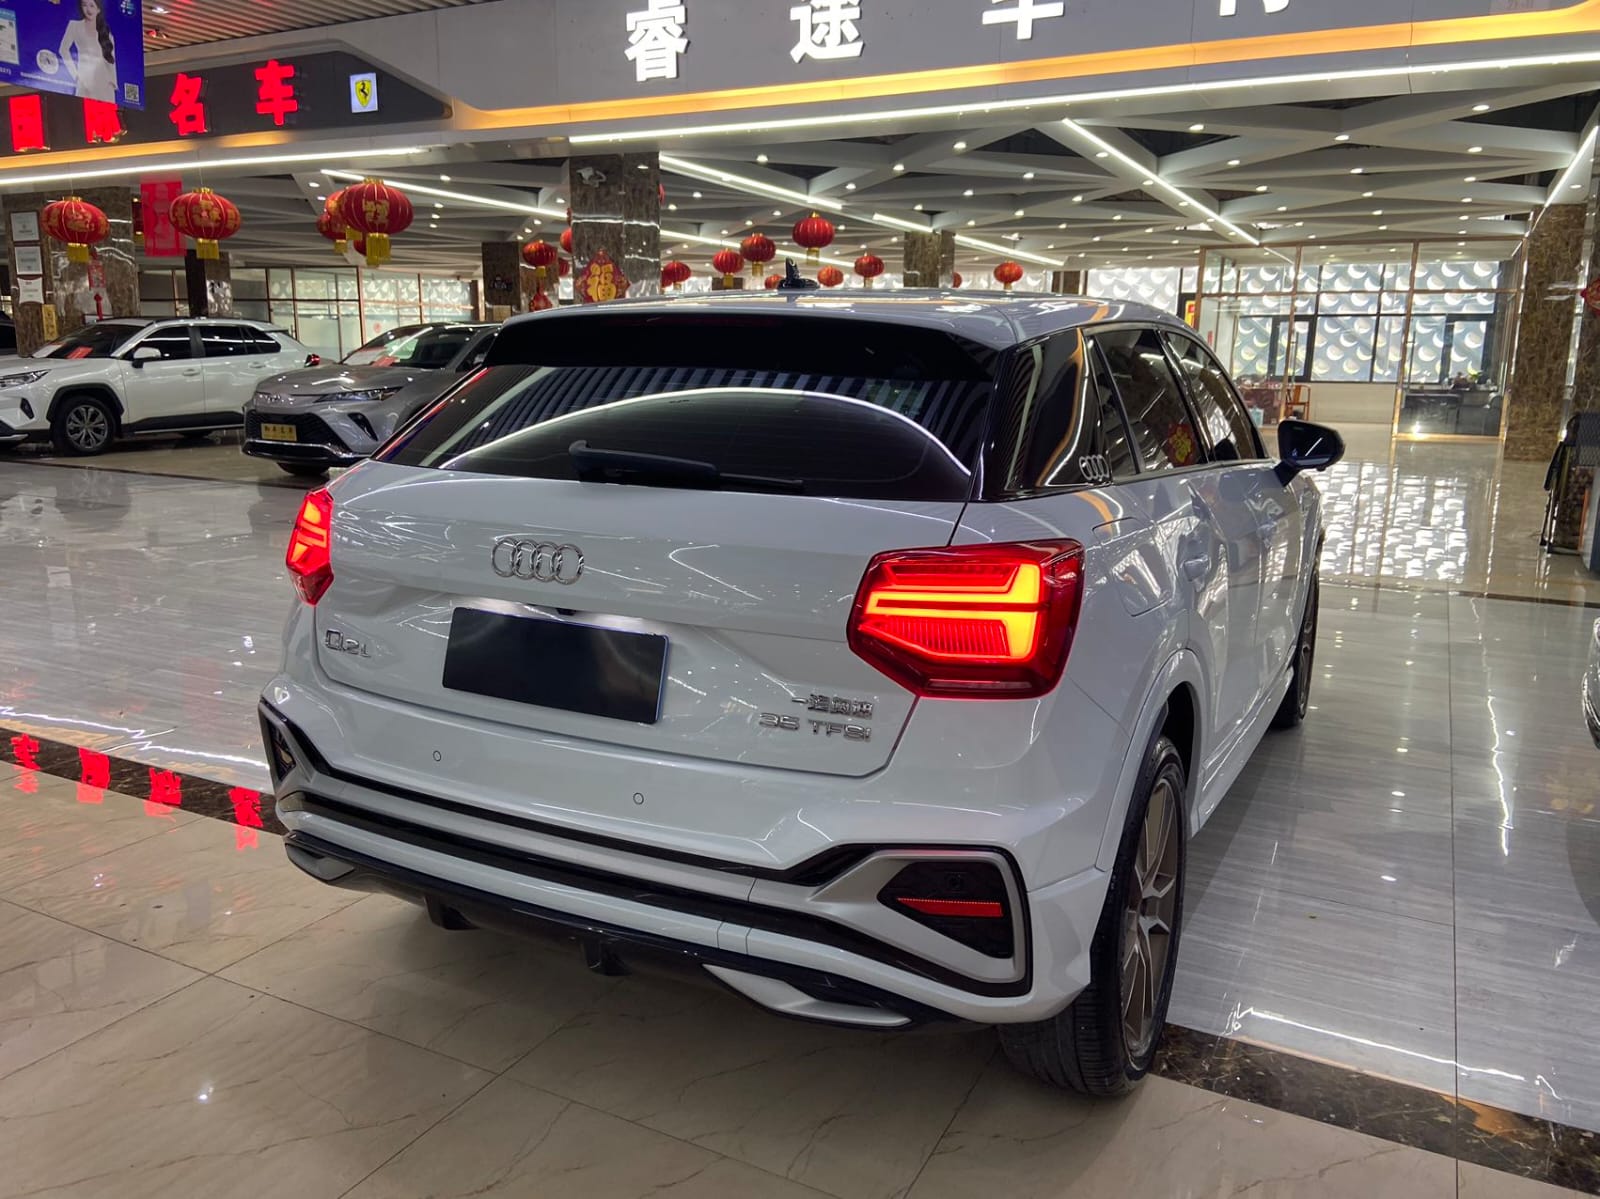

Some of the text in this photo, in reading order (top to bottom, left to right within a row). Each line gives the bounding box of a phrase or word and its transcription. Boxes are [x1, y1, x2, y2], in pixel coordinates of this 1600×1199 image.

[624, 0, 1289, 82] 睿途
[587, 263, 617, 302] 福
[325, 629, 371, 658] Q2L
[759, 711, 872, 742] 35 TFSI
